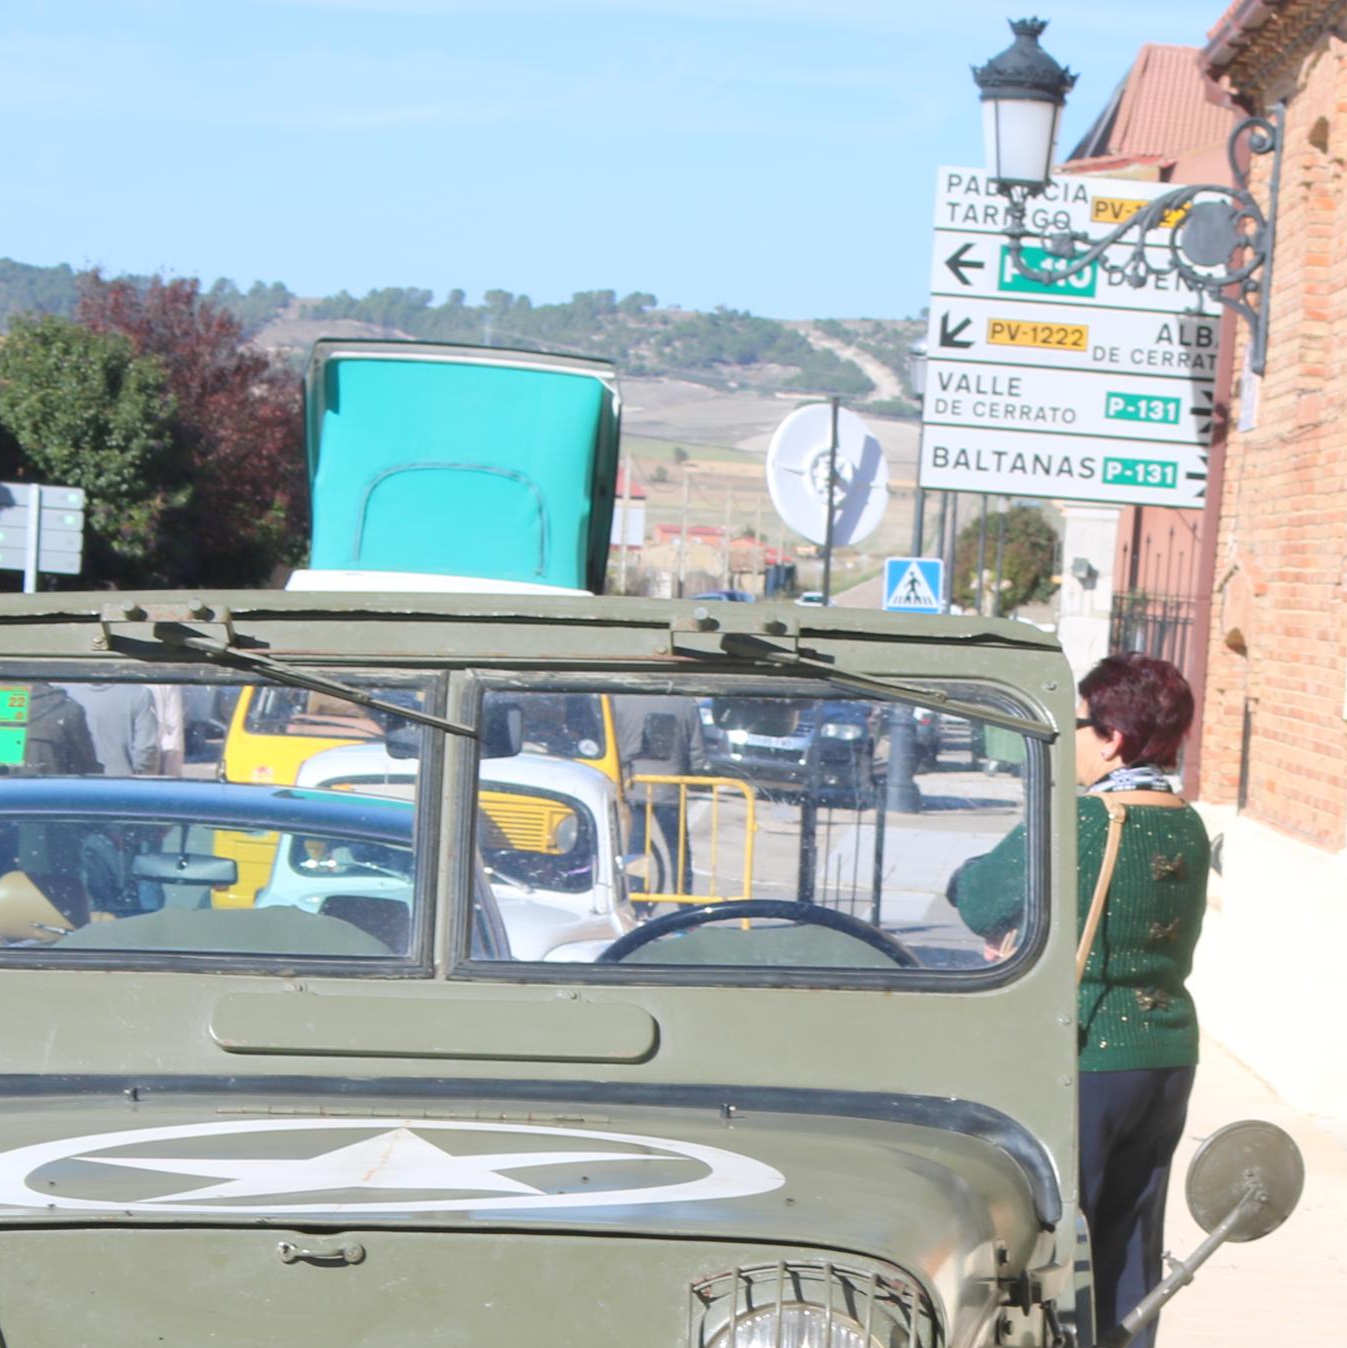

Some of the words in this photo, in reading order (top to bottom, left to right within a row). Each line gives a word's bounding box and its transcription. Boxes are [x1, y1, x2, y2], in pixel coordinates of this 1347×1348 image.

[991, 322, 1084, 347] PV-1222
[1155, 323, 1218, 348] ALB
[1093, 346, 1120, 363] DE
[1130, 349, 1217, 370] CERRAT
[938, 371, 1022, 397] VALLE
[934, 398, 963, 416] DE
[972, 401, 1077, 424] CERRATO
[1108, 397, 1177, 421] P-131
[932, 446, 1095, 479] BALTANAS
[1106, 460, 1174, 485] P-131
